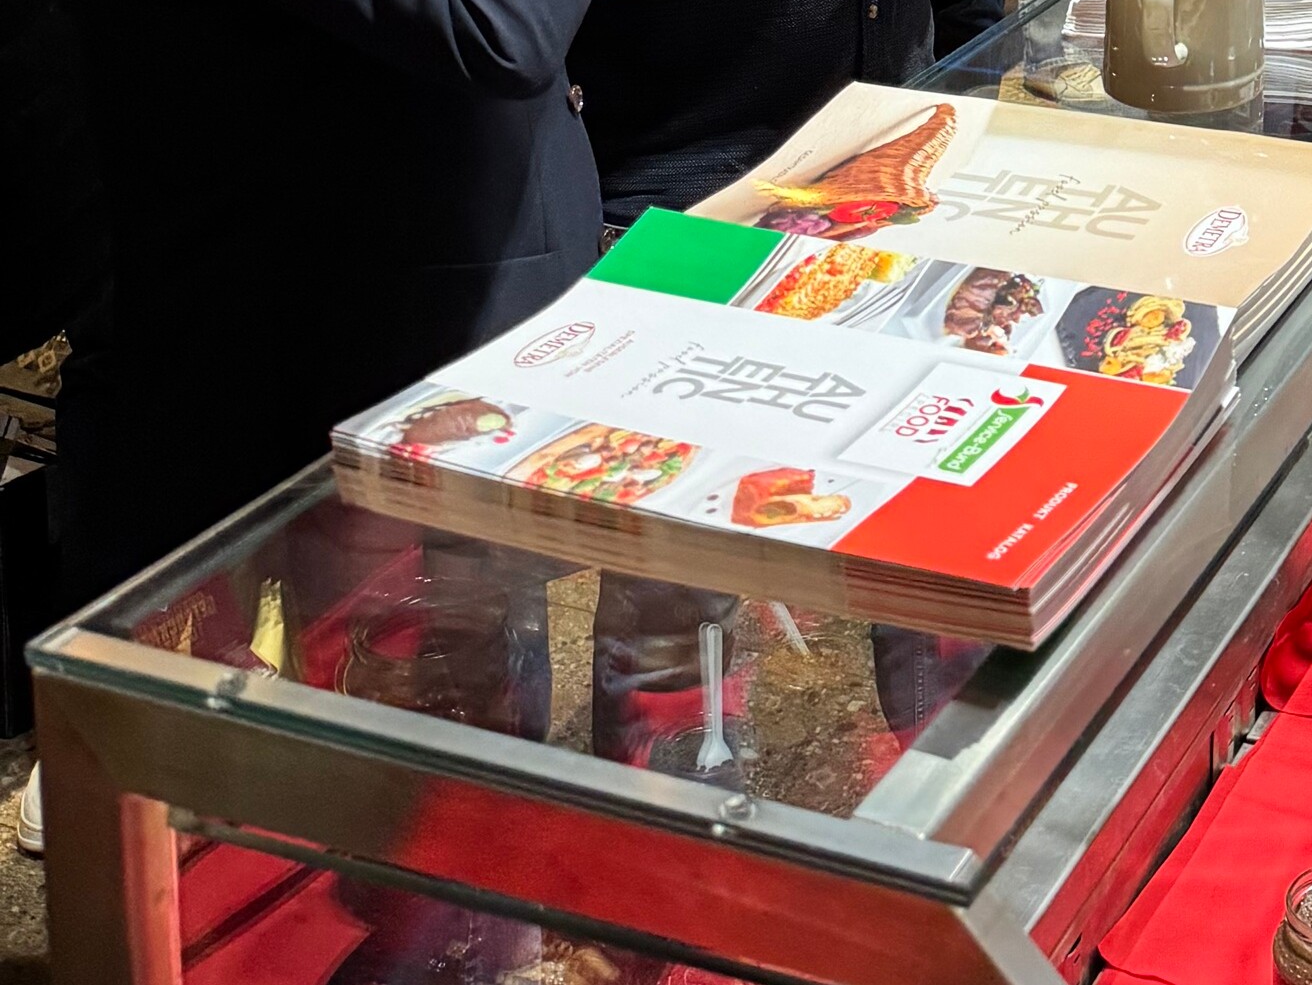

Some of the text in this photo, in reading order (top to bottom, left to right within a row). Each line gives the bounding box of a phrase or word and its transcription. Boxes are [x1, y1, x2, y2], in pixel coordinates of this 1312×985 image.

[513, 321, 595, 365] DEMETRA
[895, 395, 951, 437] FOOD
[946, 408, 1014, 471] Service-Bund
[986, 481, 1079, 560] PRODUKT KATALOG
